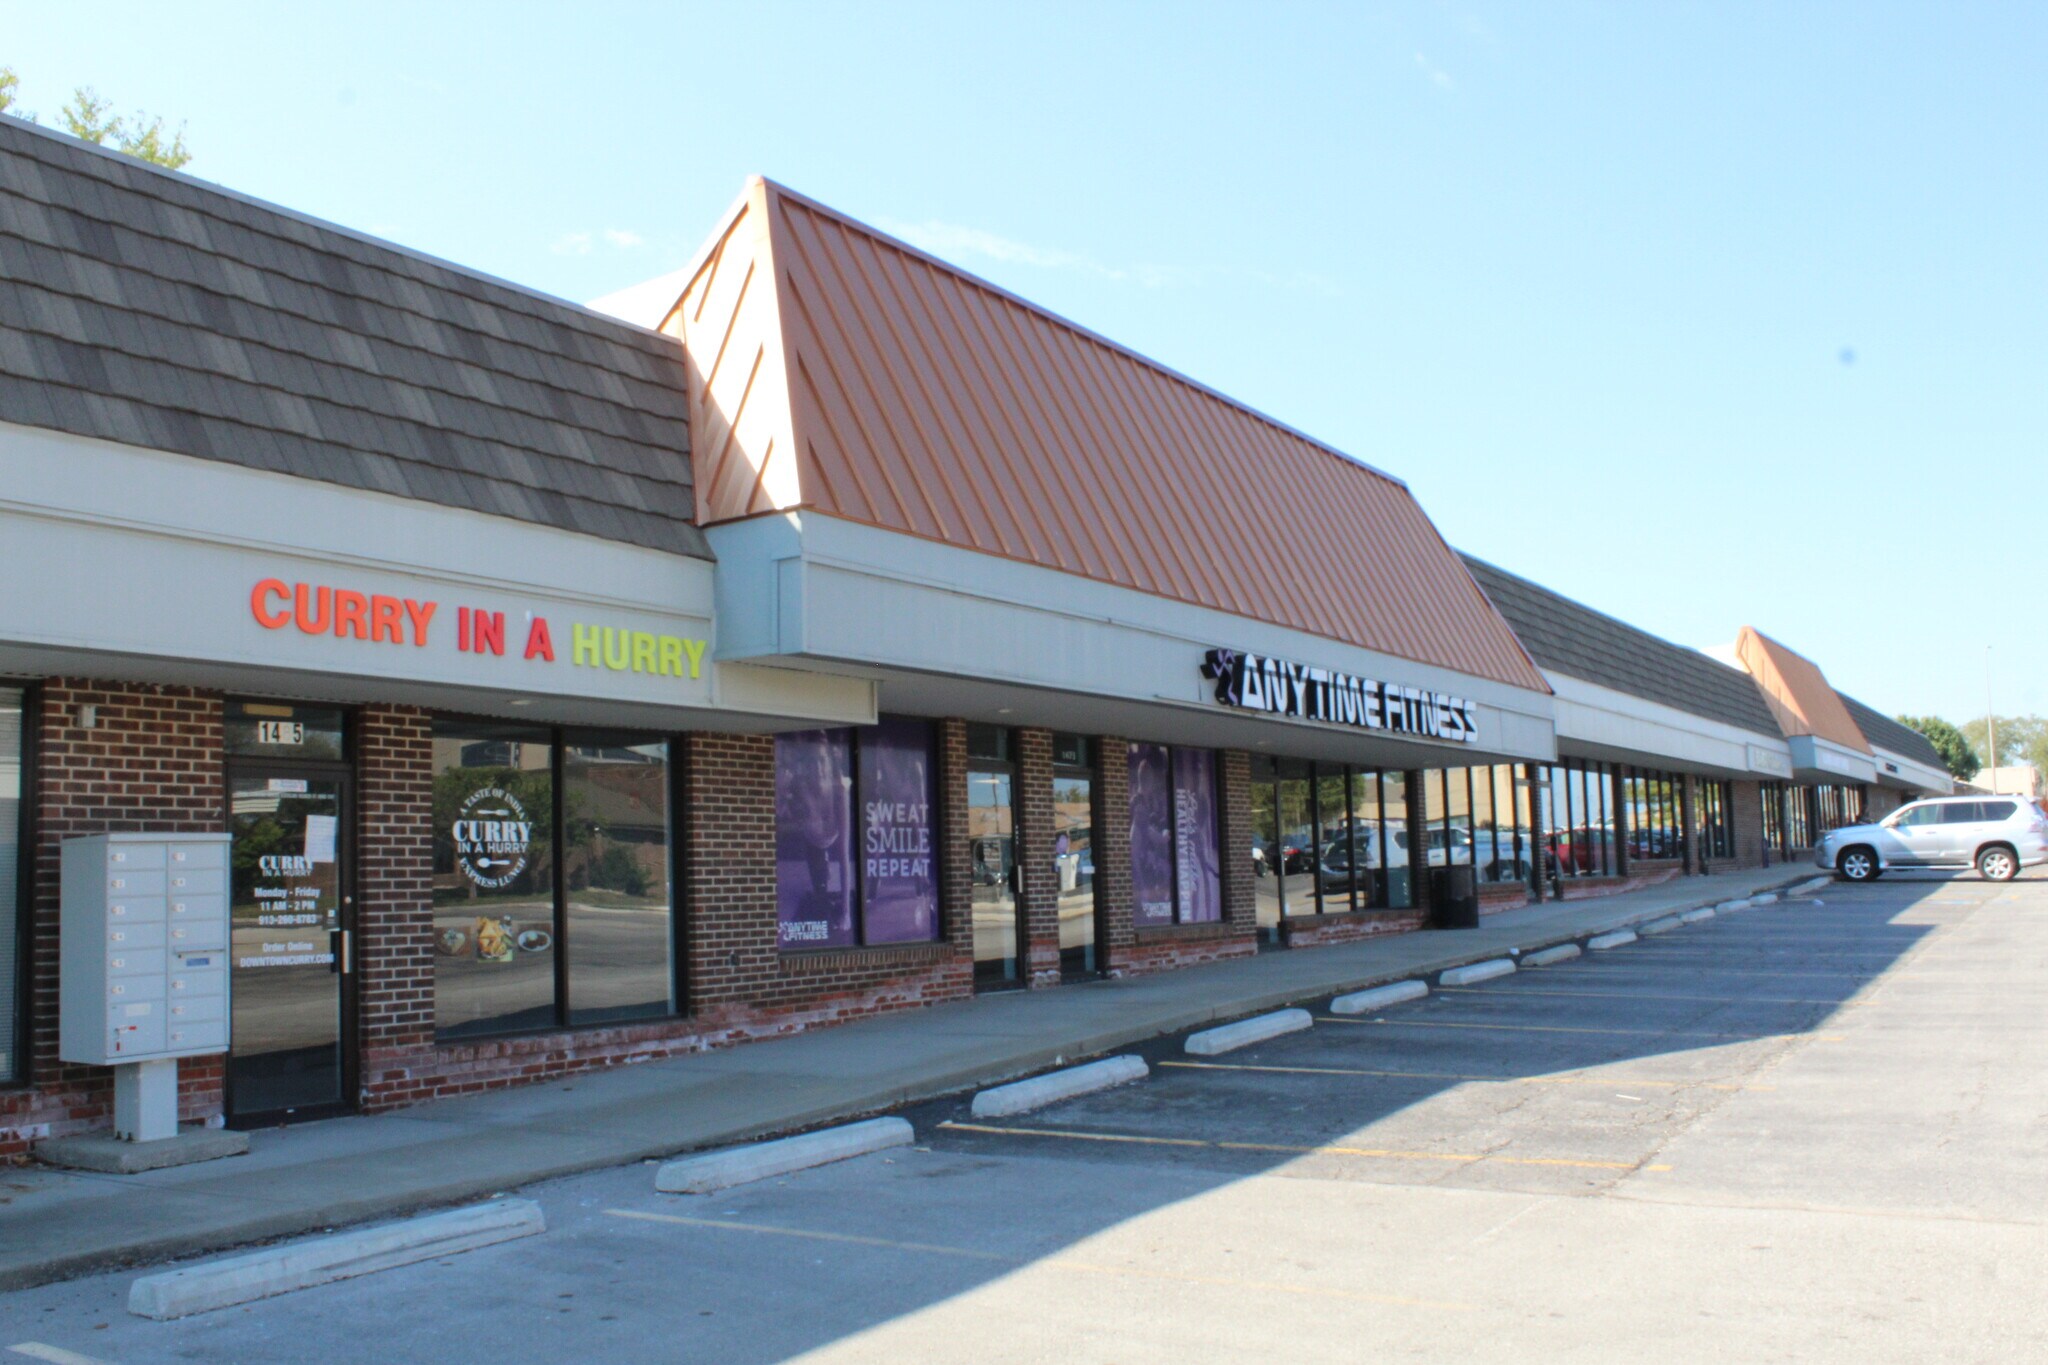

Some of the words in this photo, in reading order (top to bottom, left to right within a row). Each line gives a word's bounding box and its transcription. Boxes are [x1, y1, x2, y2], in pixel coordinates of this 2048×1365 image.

[250, 577, 437, 647] CURRY
[457, 606, 505, 656] IN
[523, 616, 555, 662] A
[572, 622, 707, 680] HURRY
[1241, 652, 1382, 729] ANYTIME
[1383, 681, 1478, 743] FITNESS
[460, 807, 468, 816] A
[464, 788, 491, 807] TASTE
[491, 788, 505, 798] OF
[504, 793, 525, 819] INDIA
[866, 801, 928, 823] SWEAT
[453, 820, 533, 843] CURRY
[1176, 788, 1188, 855] HEALTHY
[457, 842, 471, 853] IN
[474, 842, 483, 853] A
[487, 842, 528, 853] HURRY
[866, 826, 930, 853] SMILE
[259, 855, 314, 870] CURRY
[262, 869, 272, 877] IN
[274, 869, 281, 877] A
[283, 869, 312, 877] HURRY
[460, 857, 497, 888] EXPRESS
[499, 857, 526, 887] LUNCH
[866, 858, 930, 877] REPEAT
[254, 887, 288, 898] Monday
[294, 887, 321, 898] Friday
[1179, 858, 1190, 920] HAPPEN
[260, 901, 271, 911] 11
[272, 901, 287, 911] AM
[294, 901, 301, 911] 2
[302, 901, 316, 911] PM
[262, 943, 285, 953] Order
[287, 941, 313, 951] Online
[240, 953, 334, 968] DOWNTOWNCURRY.COM
